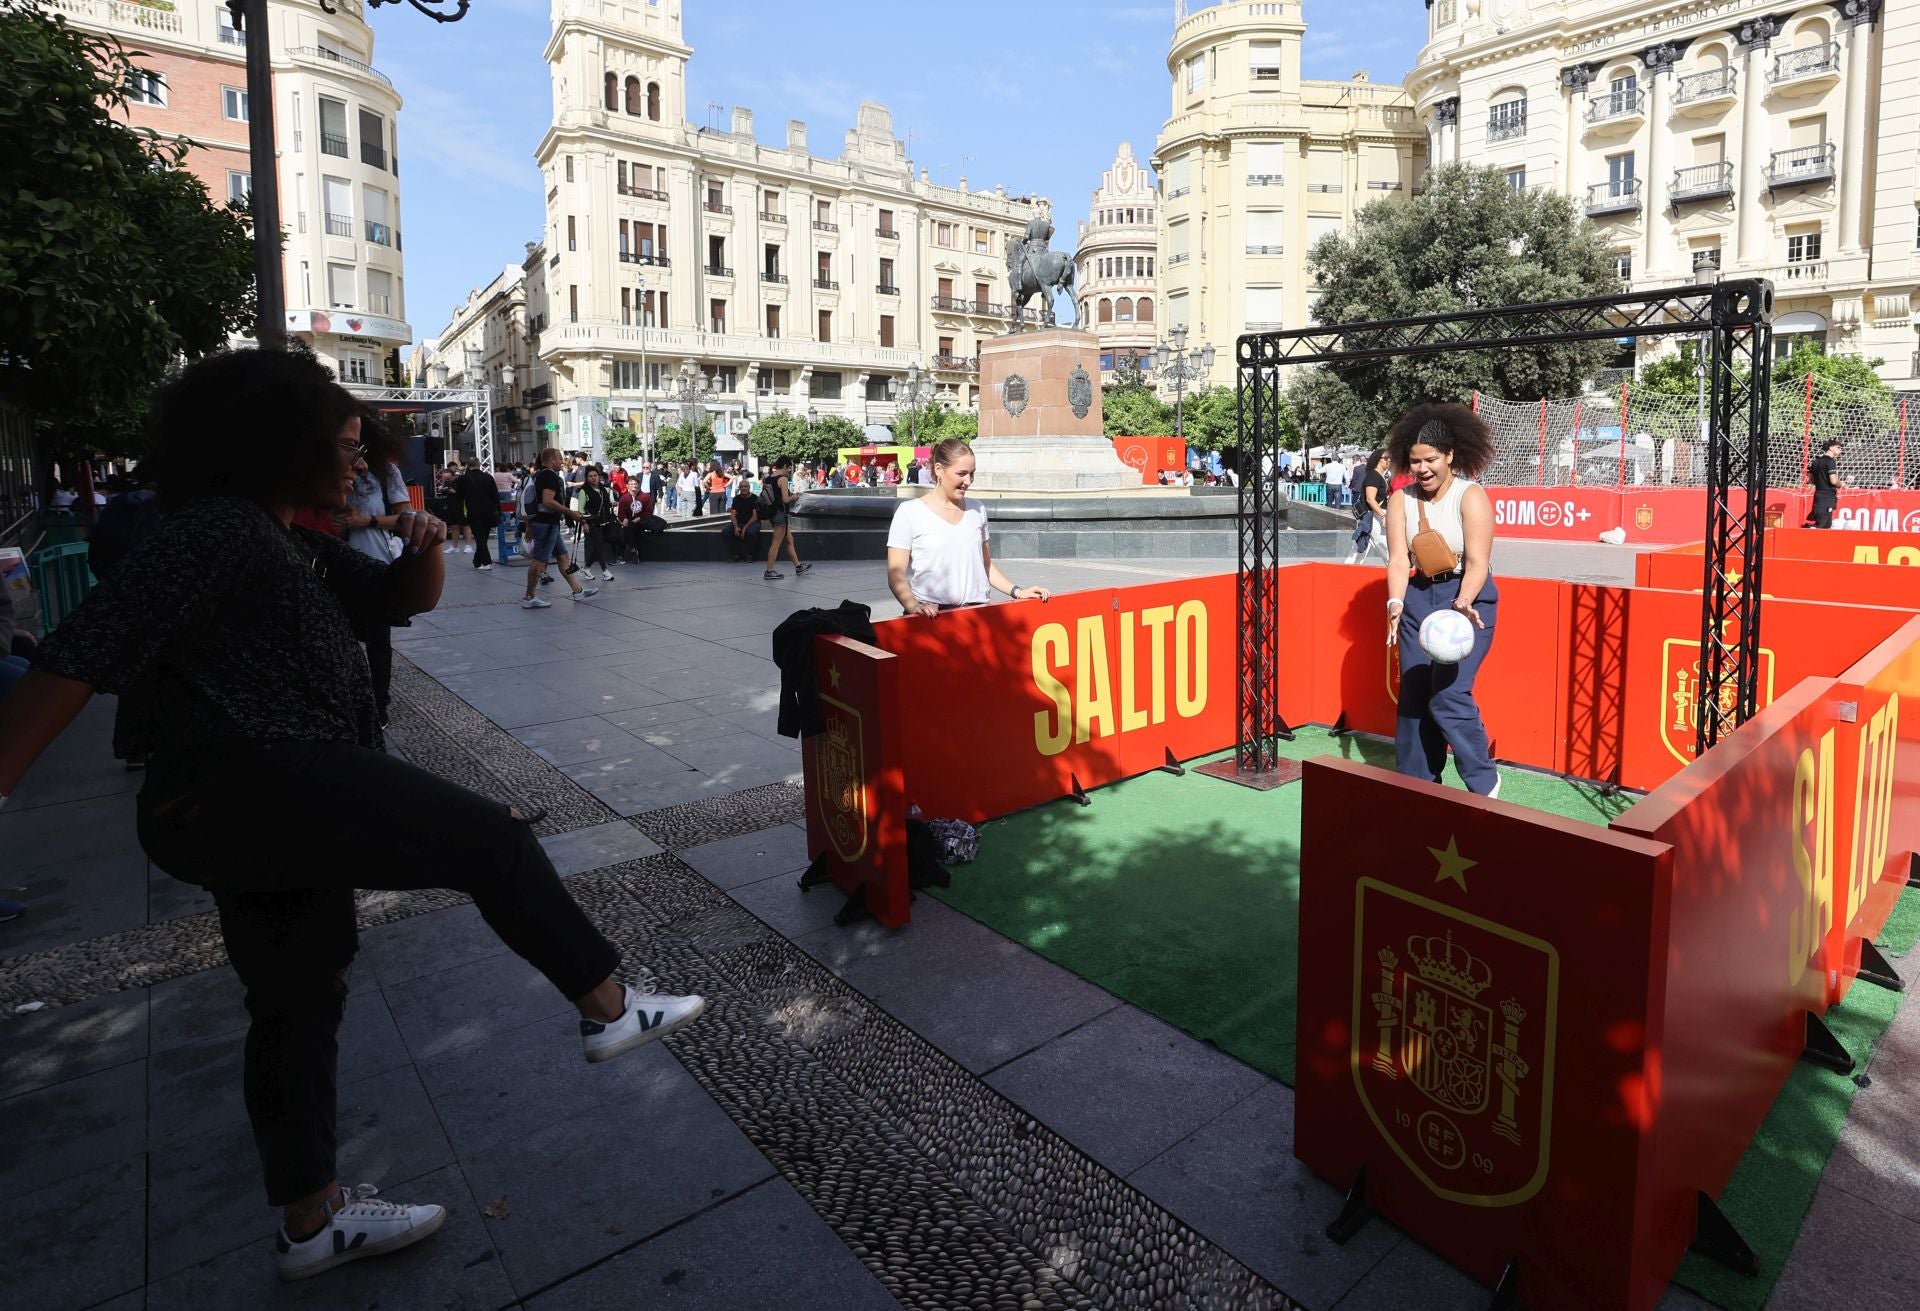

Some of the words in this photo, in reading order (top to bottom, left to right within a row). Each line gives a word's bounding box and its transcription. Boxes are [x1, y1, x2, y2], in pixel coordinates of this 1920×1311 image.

[1563, 34, 1615, 56] EDIFICIO
[1711, 5, 1722, 16] Y
[850, 469, 856, 477] 9
[1031, 599, 1208, 756] SALTO
[1789, 691, 1899, 986] SALTO
[1395, 1108, 1411, 1128] 19
[1472, 1152, 1494, 1174] 09
